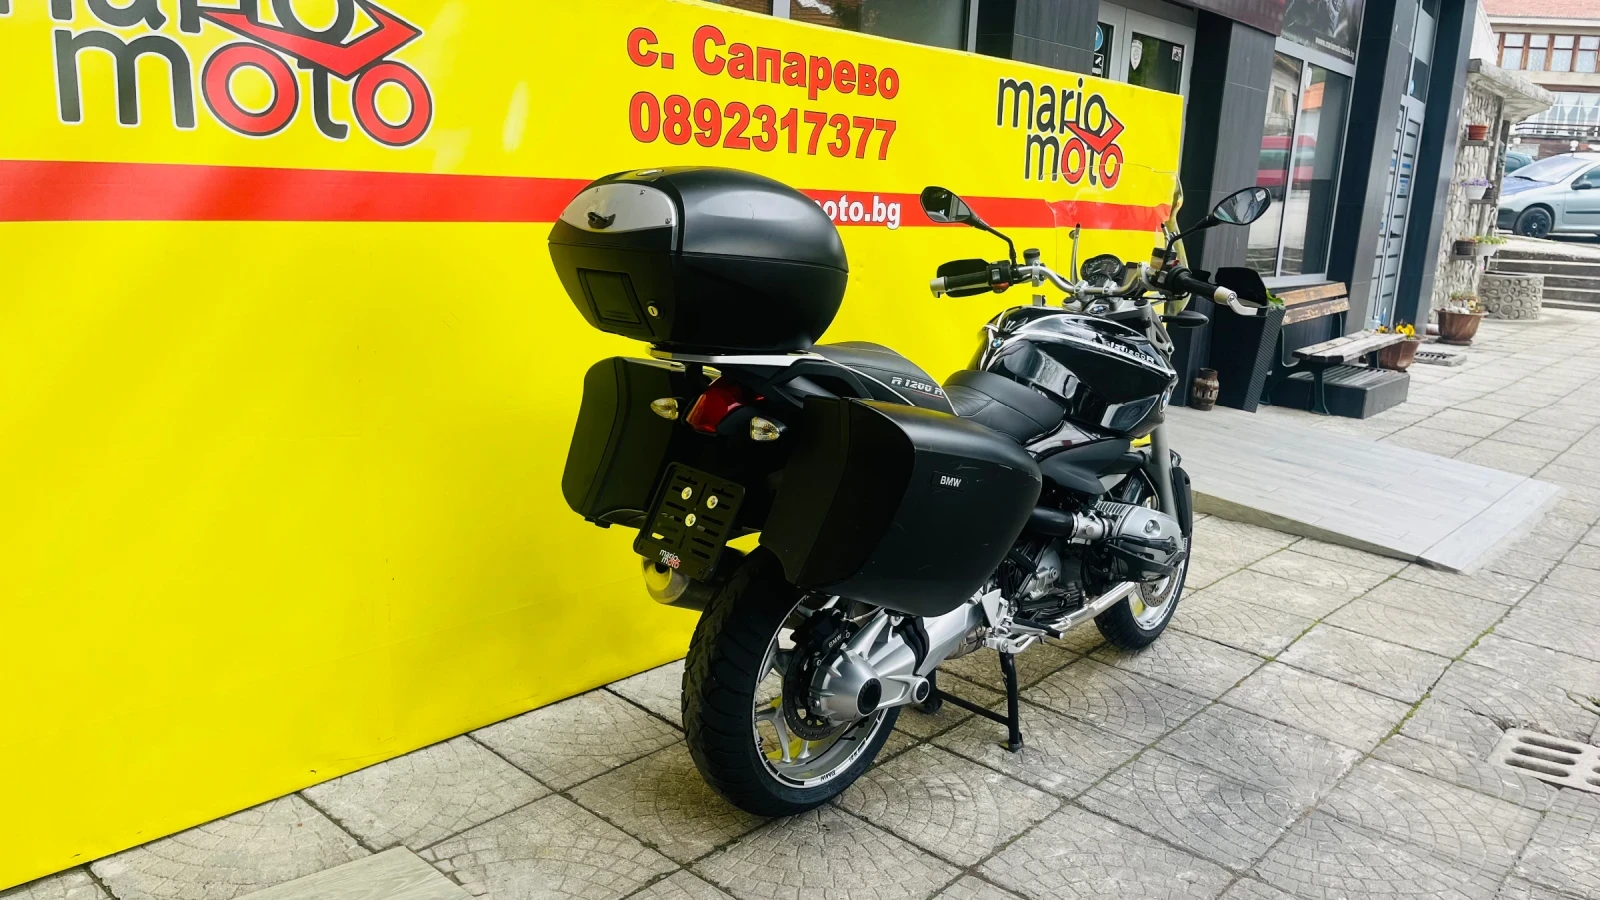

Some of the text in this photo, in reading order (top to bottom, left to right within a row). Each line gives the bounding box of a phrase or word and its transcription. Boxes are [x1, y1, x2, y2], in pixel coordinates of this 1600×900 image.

[627, 25, 900, 100] с. Сапарево
[54, 29, 433, 147] moto
[997, 78, 1107, 137] mario
[629, 91, 897, 160] 0892317377
[1025, 134, 1124, 188] moto
[815, 194, 901, 230] oto.bg
[904, 379, 931, 392] 1200
[940, 475, 962, 487] BMW
[659, 549, 679, 562] mario
[661, 556, 680, 569] moto
